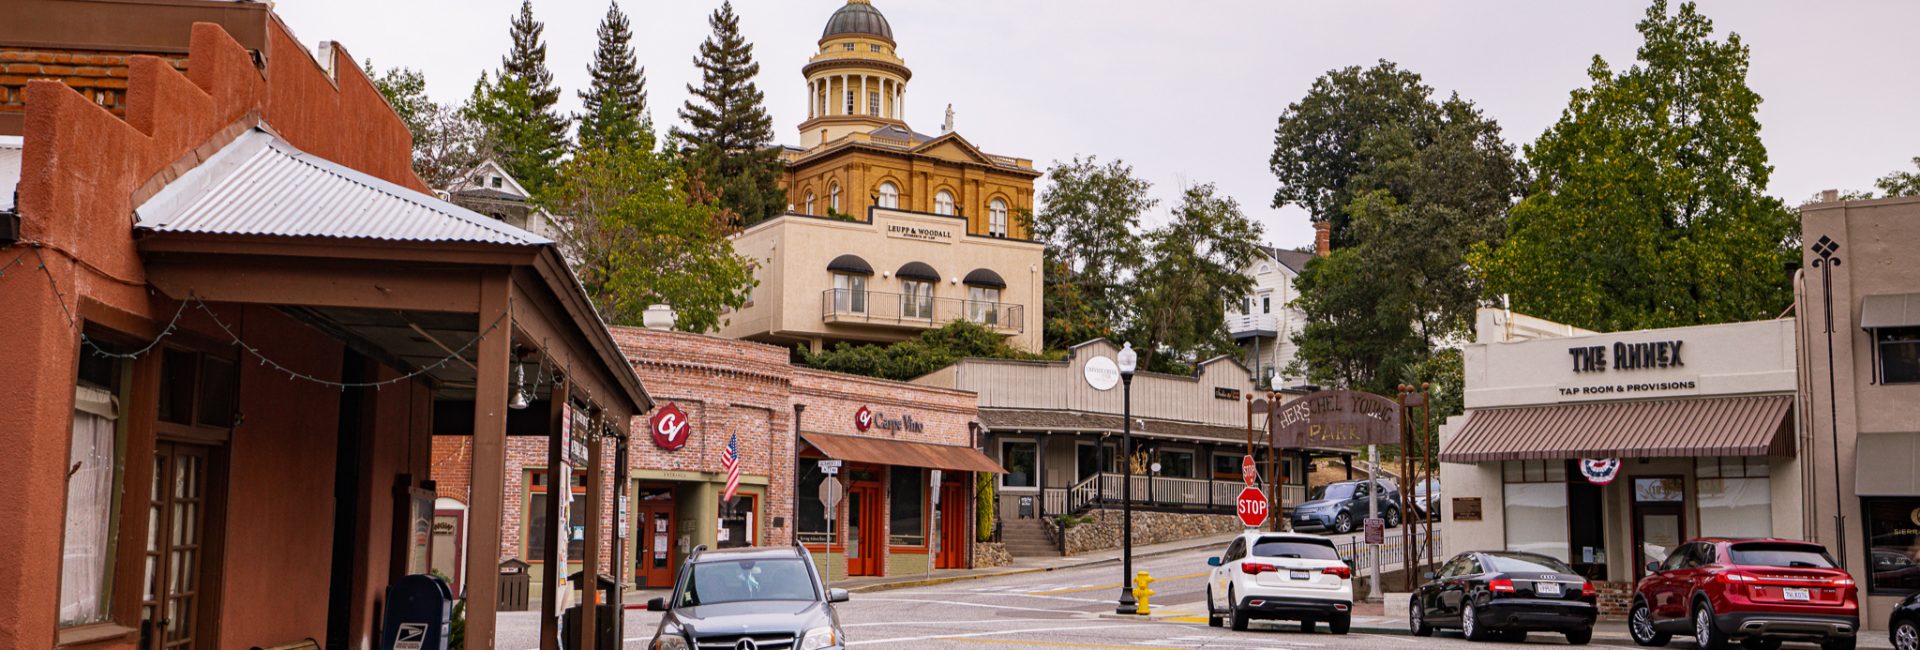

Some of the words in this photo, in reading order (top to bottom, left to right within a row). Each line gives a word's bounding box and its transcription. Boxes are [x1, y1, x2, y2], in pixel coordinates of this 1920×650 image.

[888, 225, 909, 234] LEUPP
[918, 228, 952, 238] WOODALL
[1568, 345, 1607, 373] THE
[1559, 387, 1580, 396] TAP
[1583, 385, 1614, 394] ROOM
[1616, 385, 1624, 393] &
[1627, 381, 1696, 392] PROVISIONS
[1280, 395, 1342, 429] HERSCHEL
[1352, 396, 1393, 423] YOUNG
[874, 411, 902, 436] Carpe
[902, 414, 924, 433] Vino
[1309, 423, 1360, 441] PARK
[1239, 499, 1266, 515] STOP
